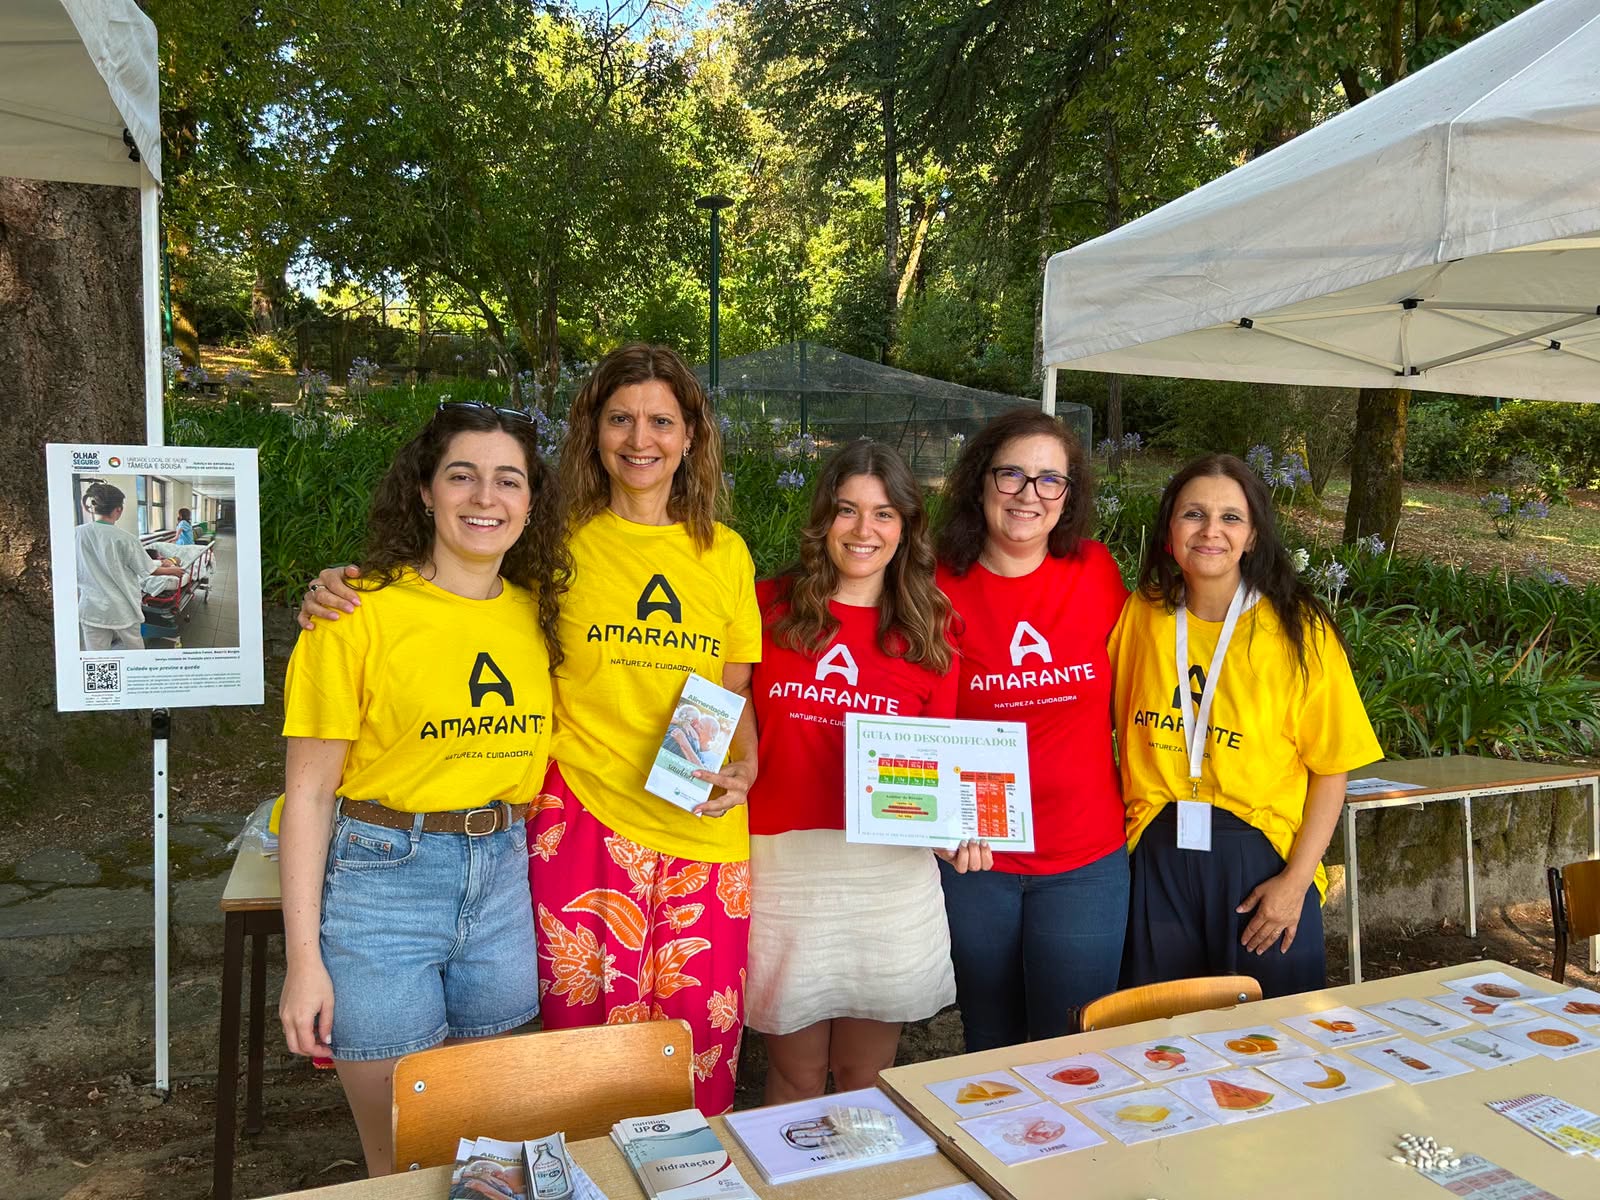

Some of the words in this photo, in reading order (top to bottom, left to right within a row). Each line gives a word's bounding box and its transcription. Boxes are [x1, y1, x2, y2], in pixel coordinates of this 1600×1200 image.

[587, 624, 721, 658] AMARANTE
[610, 658, 653, 668] NATUREZA
[655, 662, 697, 673] CUIDADORA
[970, 662, 1096, 691] AMARANTE
[769, 681, 899, 716] AMARANTE
[994, 699, 1035, 709] NATUREZA
[1036, 695, 1078, 705] CUIDADORA
[687, 694, 730, 719] Alimentação
[789, 711, 828, 724] NATUREZA
[1134, 709, 1244, 750] AMARNTE
[862, 730, 892, 741] GUIA
[894, 732, 911, 742] DO
[913, 733, 1018, 748] DESCODIFICADOR
[486, 750, 534, 760] CUIDADORA
[632, 1119, 666, 1127] nutrition
[634, 1125, 651, 1133] UP
[655, 1159, 716, 1173] Hidratação
